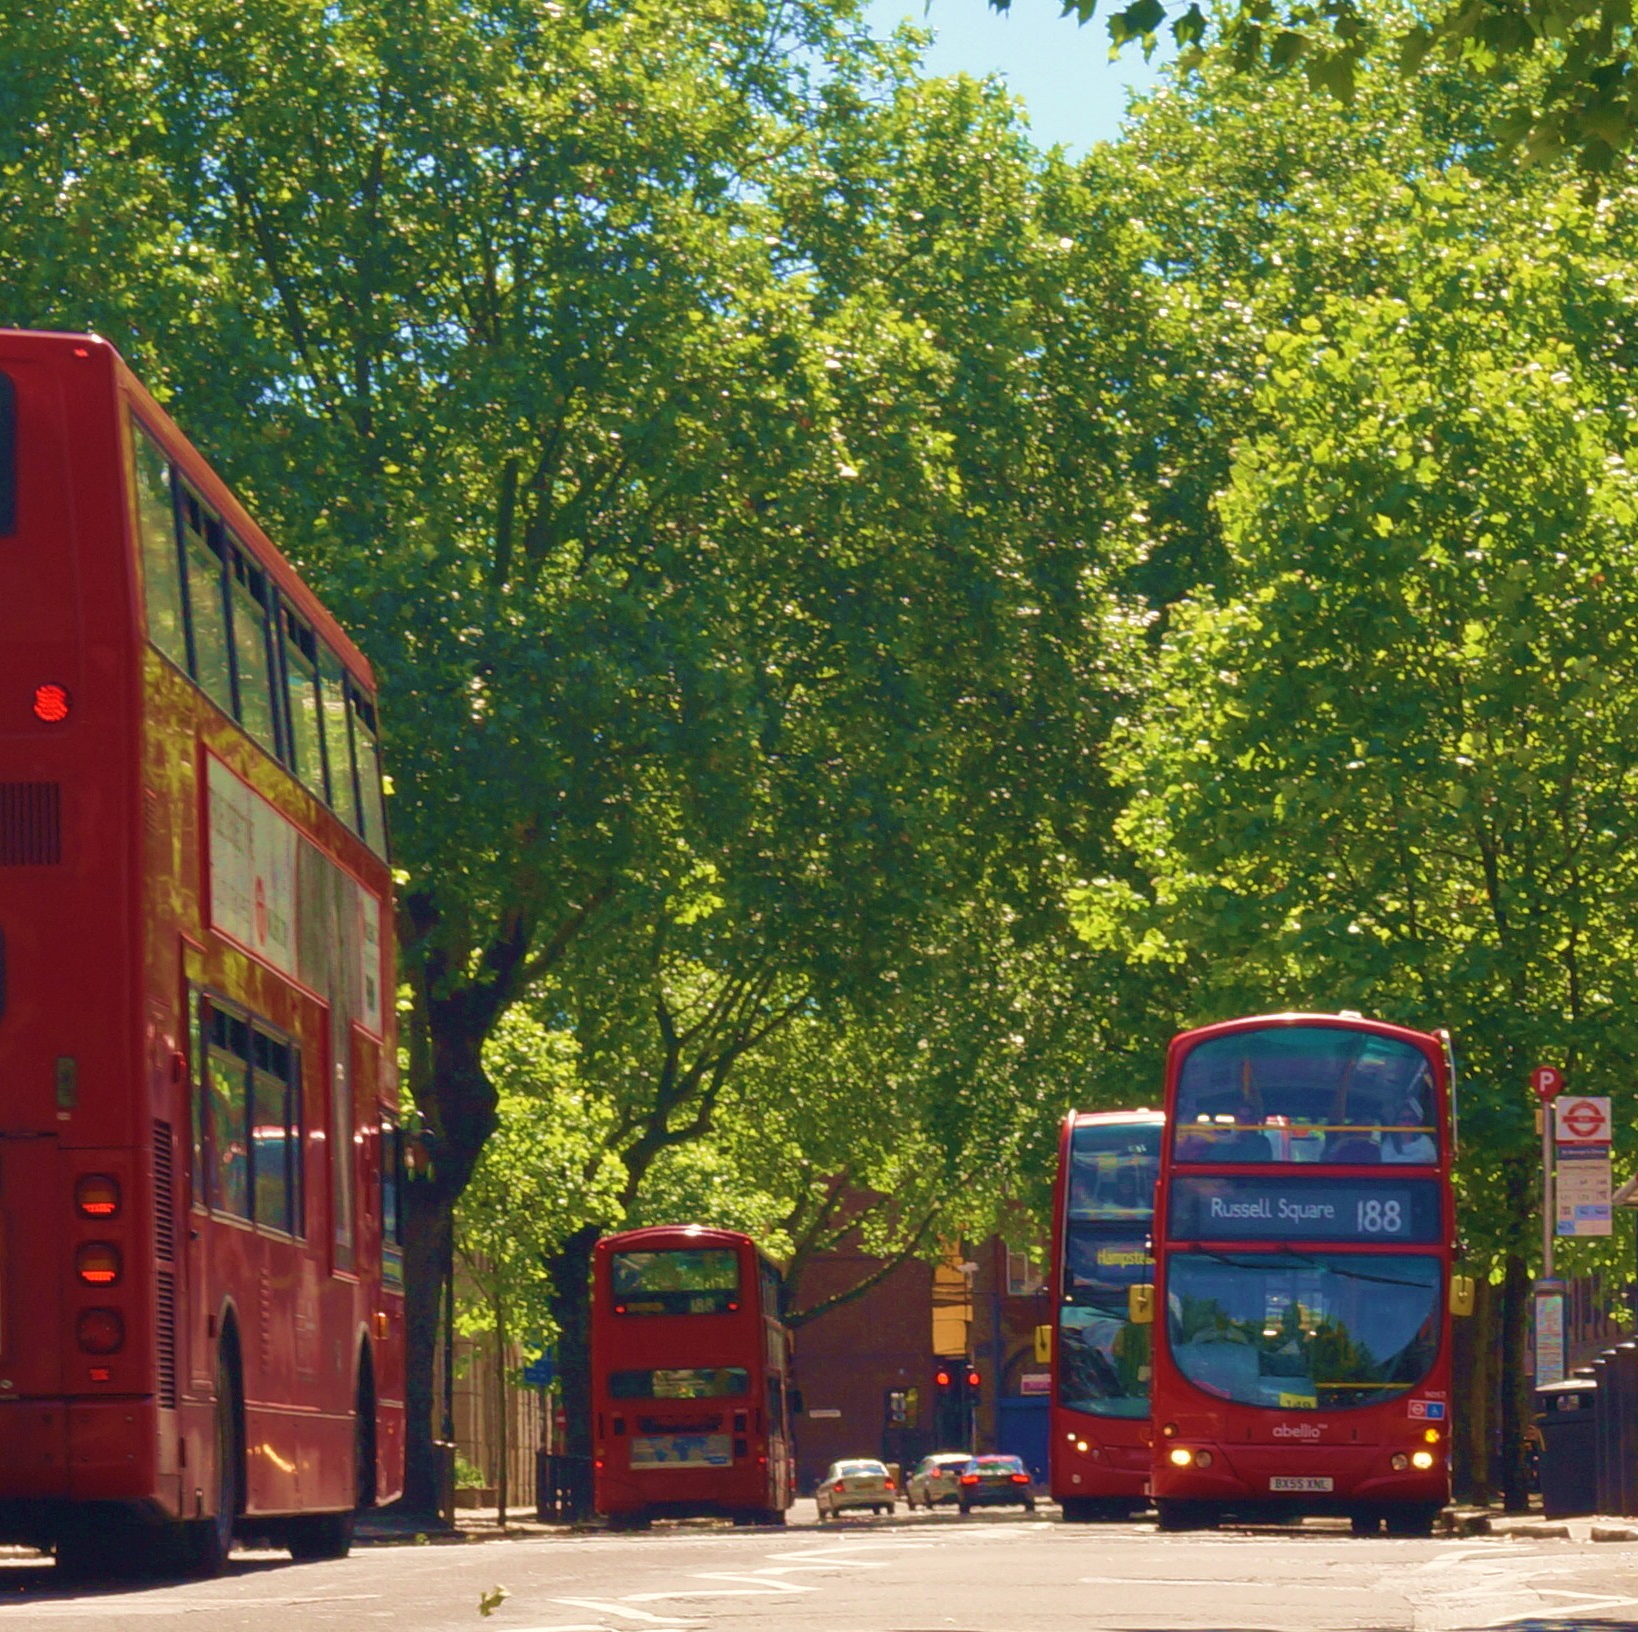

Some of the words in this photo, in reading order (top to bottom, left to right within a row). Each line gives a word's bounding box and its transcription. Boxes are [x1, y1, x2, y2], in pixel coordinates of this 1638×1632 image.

[1540, 1071, 1554, 1091] P
[1211, 1197, 1272, 1218] Russell
[1278, 1198, 1335, 1224] Square
[1357, 1199, 1402, 1232] 188
[1272, 1423, 1321, 1438] abellio
